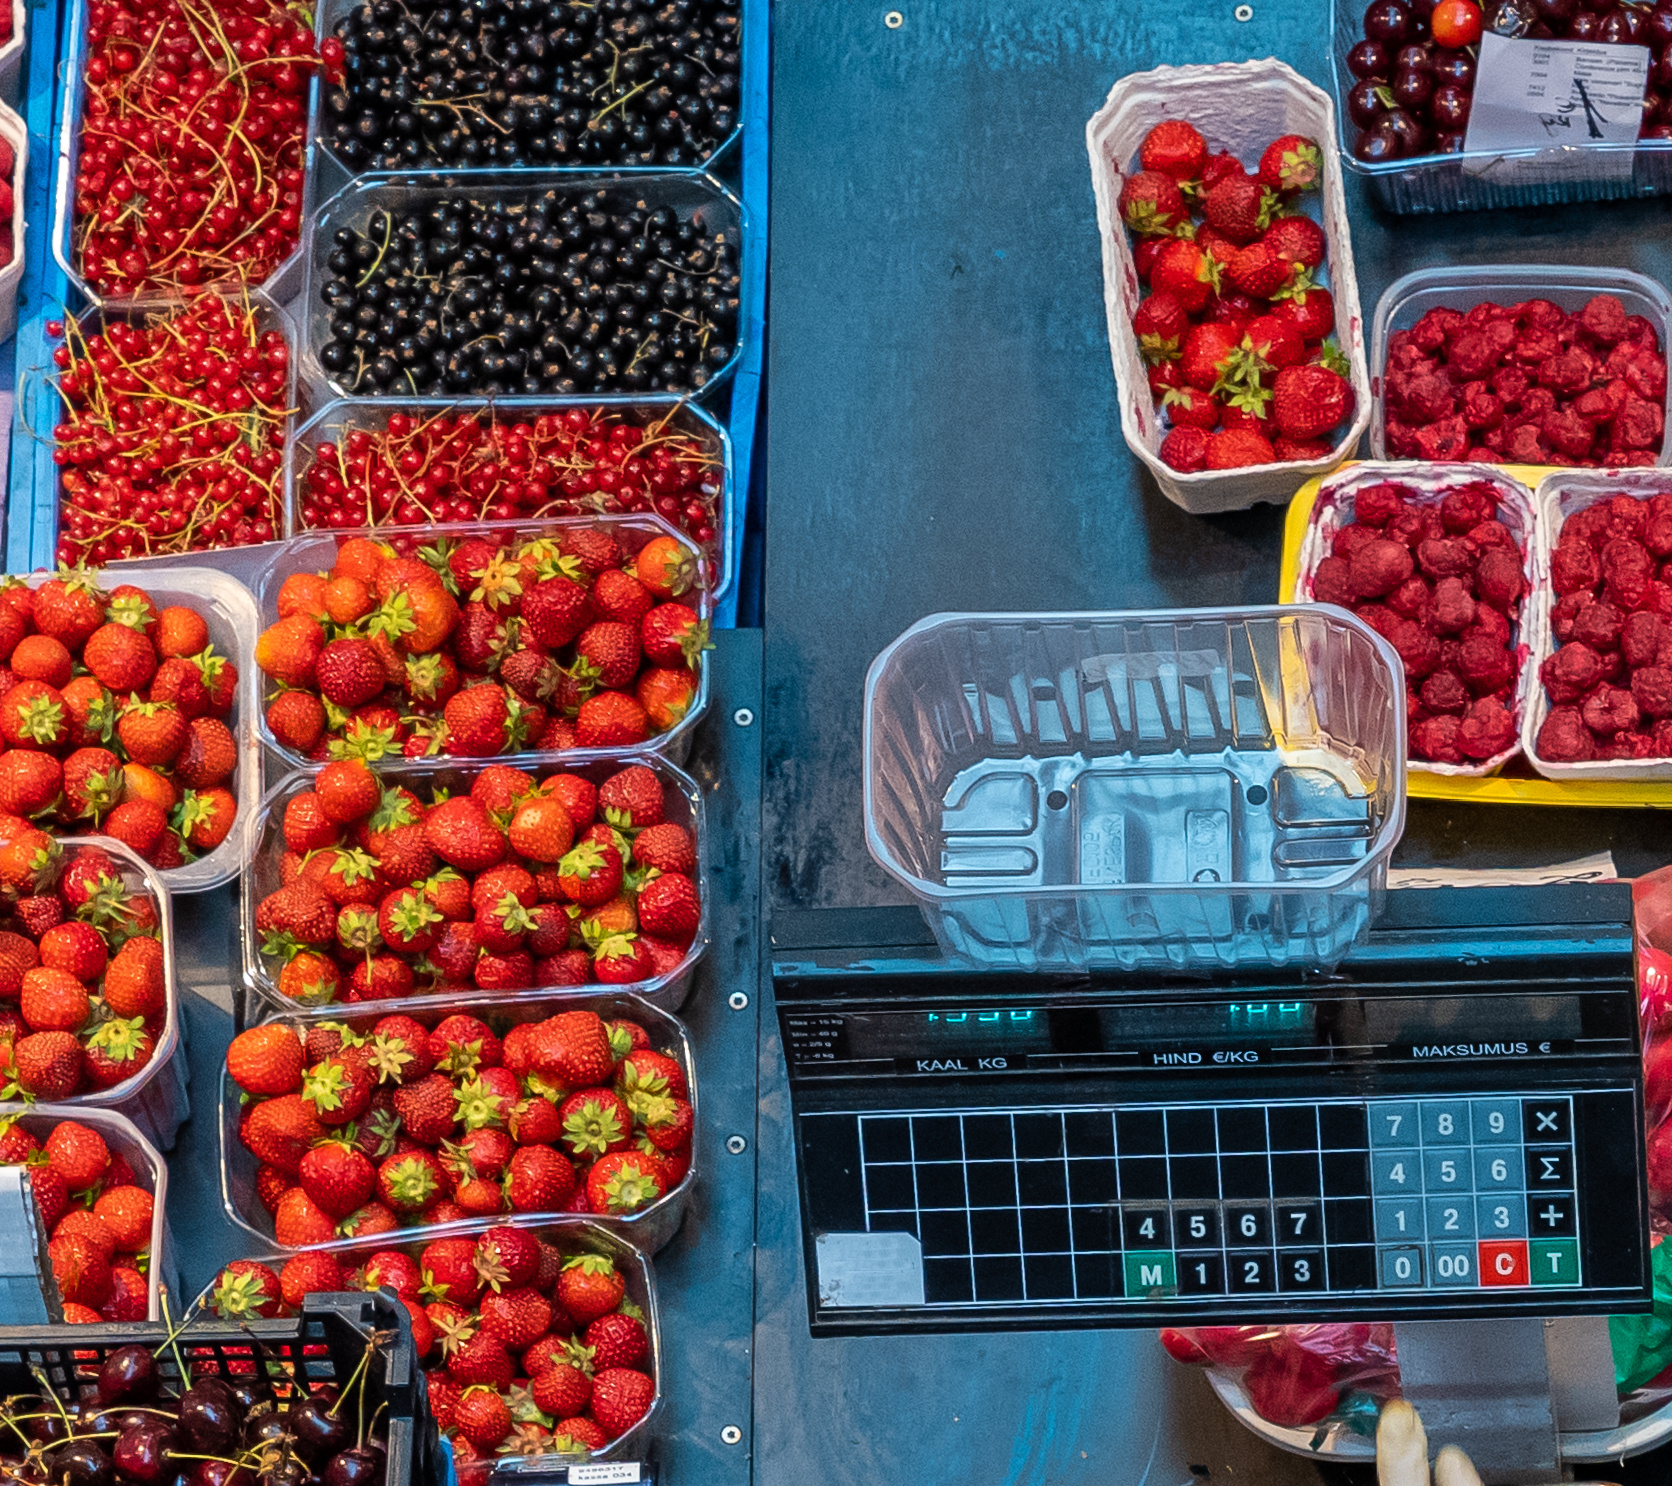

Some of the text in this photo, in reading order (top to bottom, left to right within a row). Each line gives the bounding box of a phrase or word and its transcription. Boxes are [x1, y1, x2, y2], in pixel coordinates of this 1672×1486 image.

[1153, 1050, 1259, 1065] HIND €/KG
[1412, 1041, 1529, 1058] MAKSUMUS
[916, 1055, 1008, 1073] KAAL KG
[1385, 1111, 1505, 1137] 7 8 9
[1389, 1163, 1406, 1184] 4
[1440, 1160, 1457, 1182] 5
[1490, 1159, 1507, 1181] 6
[1139, 1214, 1308, 1239] 4 5 6 7
[1395, 1207, 1510, 1232] 1 2 3
[1140, 1252, 1563, 1287] M 1 2 3 0 00 C T
